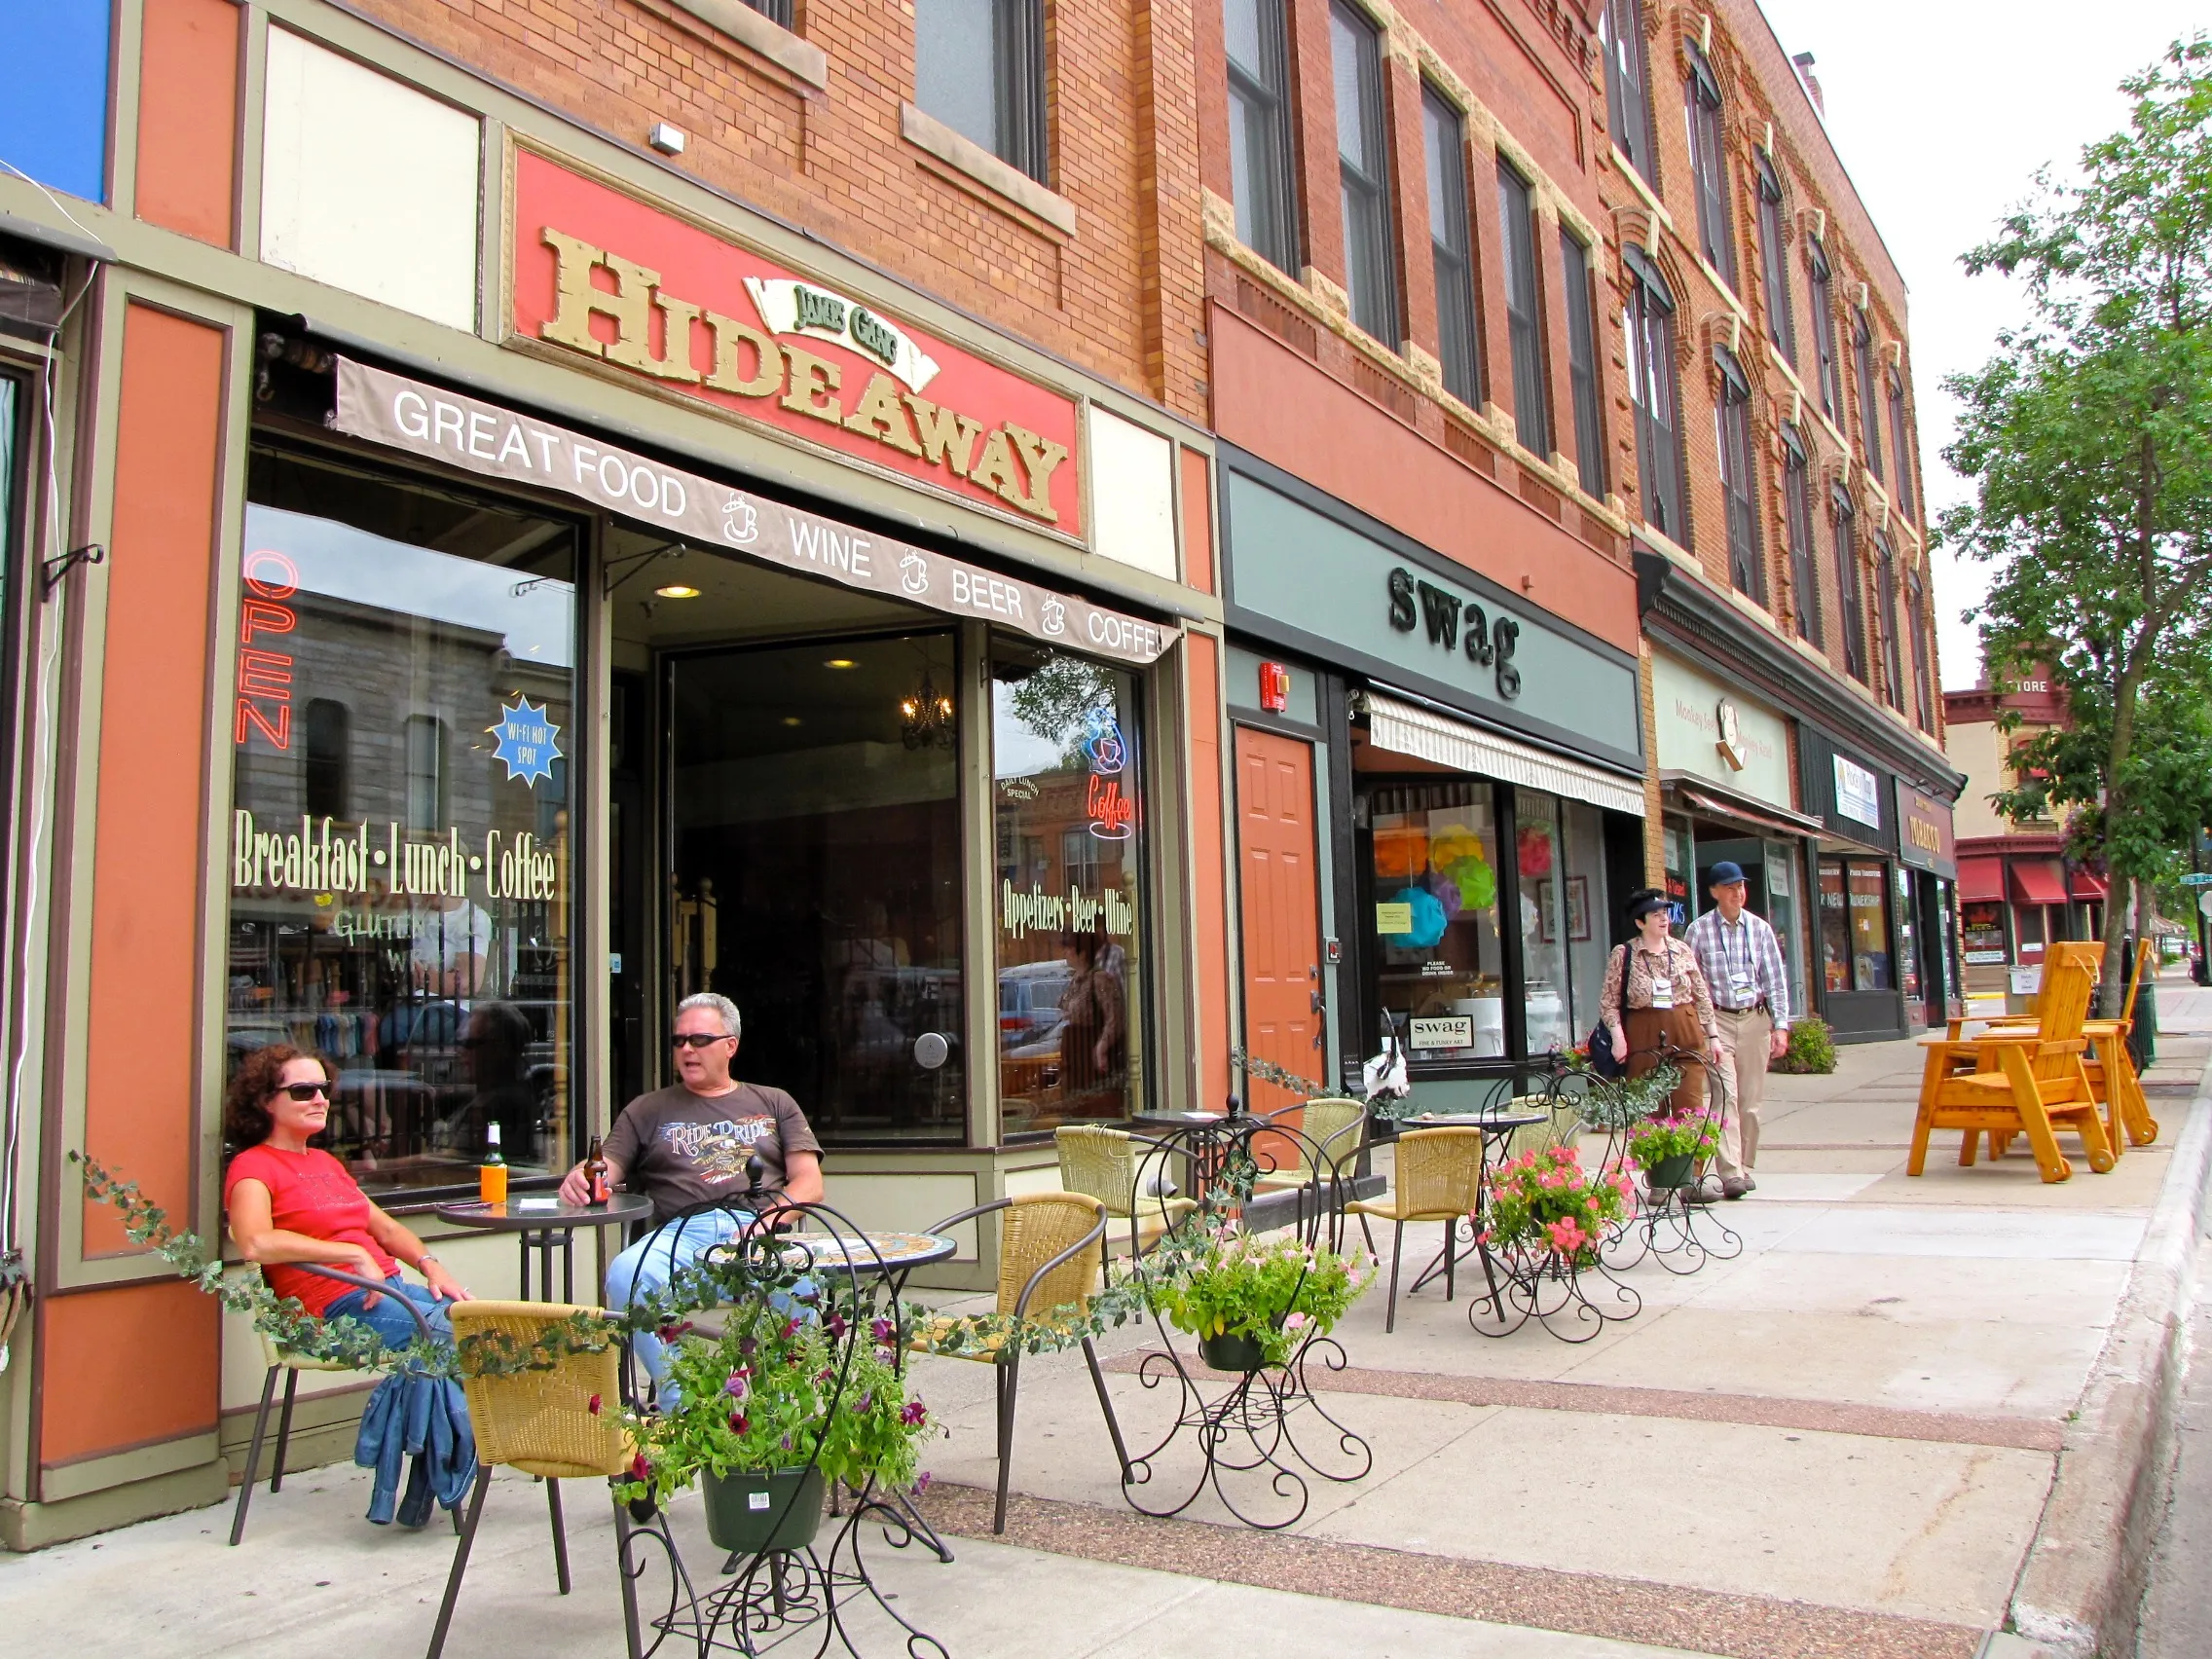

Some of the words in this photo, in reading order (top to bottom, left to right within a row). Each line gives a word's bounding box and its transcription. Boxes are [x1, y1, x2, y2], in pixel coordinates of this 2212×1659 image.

[850, 306, 898, 366] GANG
[537, 226, 1068, 523] HIDEAWAY
[393, 390, 561, 473] GREAT
[572, 443, 687, 517] FOOD
[789, 517, 872, 577] WINE
[952, 569, 1024, 619] BEER
[235, 549, 299, 750] OPEN
[1387, 566, 1522, 700] swag
[2008, 680, 2047, 692] TORE
[507, 721, 530, 742] WI-FI
[532, 725, 547, 745] HOT
[517, 746, 537, 765] SPOT
[1001, 776, 1018, 791] DAILY
[1018, 776, 1040, 796] LUNCH
[1007, 789, 1032, 799] SPECIAL
[1088, 774, 1131, 830] Coffee
[234, 809, 368, 893] Breakfast
[389, 822, 465, 897] Lunch
[486, 830, 555, 900] Coffee
[1004, 878, 1064, 939] Appetizers
[1071, 884, 1097, 933] Beer
[1104, 888, 1132, 935] Wine
[1415, 1020, 1467, 1035] swag
[713, 1120, 770, 1145] PRIDE
